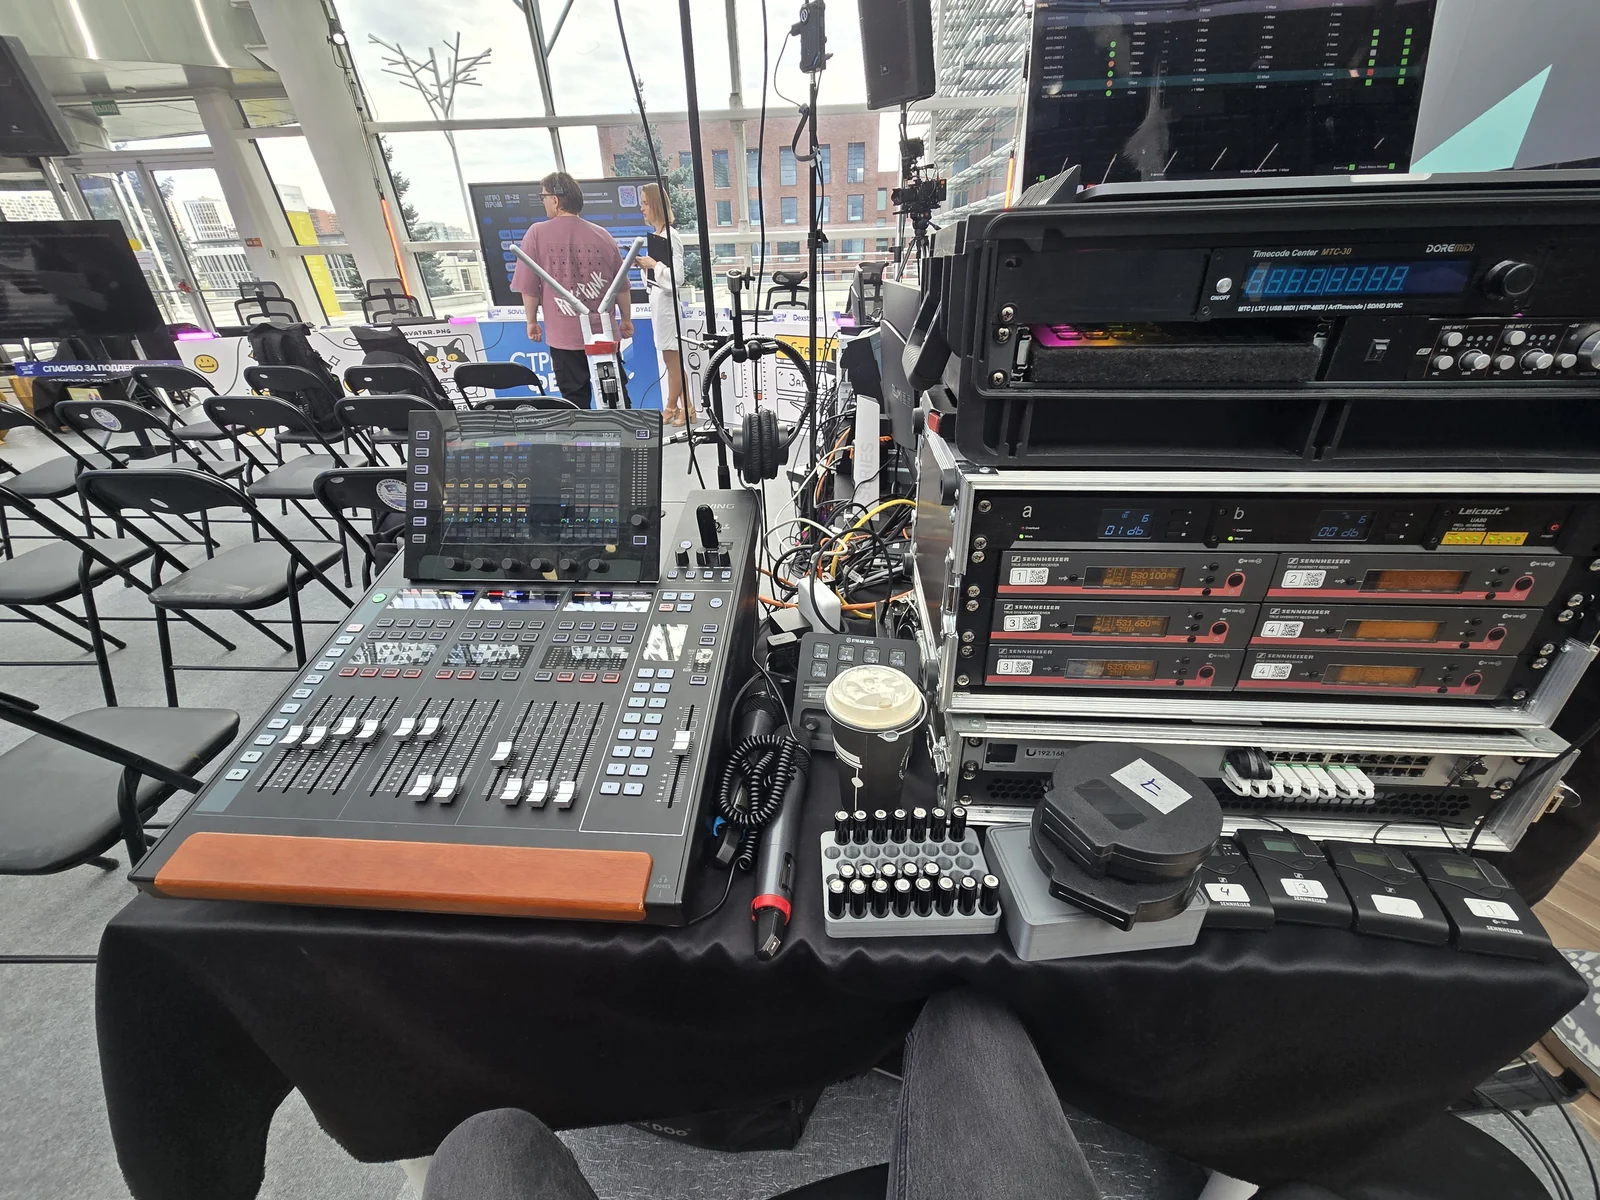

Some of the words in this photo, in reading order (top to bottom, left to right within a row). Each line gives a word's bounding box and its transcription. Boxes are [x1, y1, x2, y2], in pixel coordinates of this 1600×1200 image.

[1252, 250, 1290, 258] Timecode
[1291, 249, 1319, 257] Center
[1321, 247, 1353, 256] MTC-30
[404, 328, 451, 337] AVATAR.PNG
[42, 364, 83, 373] СПАСИБО
[84, 364, 97, 372] ЗА
[1022, 505, 1033, 518] a
[1233, 507, 1245, 520] b
[1458, 507, 1504, 515] Leicozic
[1141, 514, 1150, 523] 6
[1220, 886, 1230, 896] 4
[1298, 882, 1309, 894] 3
[1294, 896, 1327, 904] SENNHEISER
[1486, 925, 1524, 936] SENNHEISER
